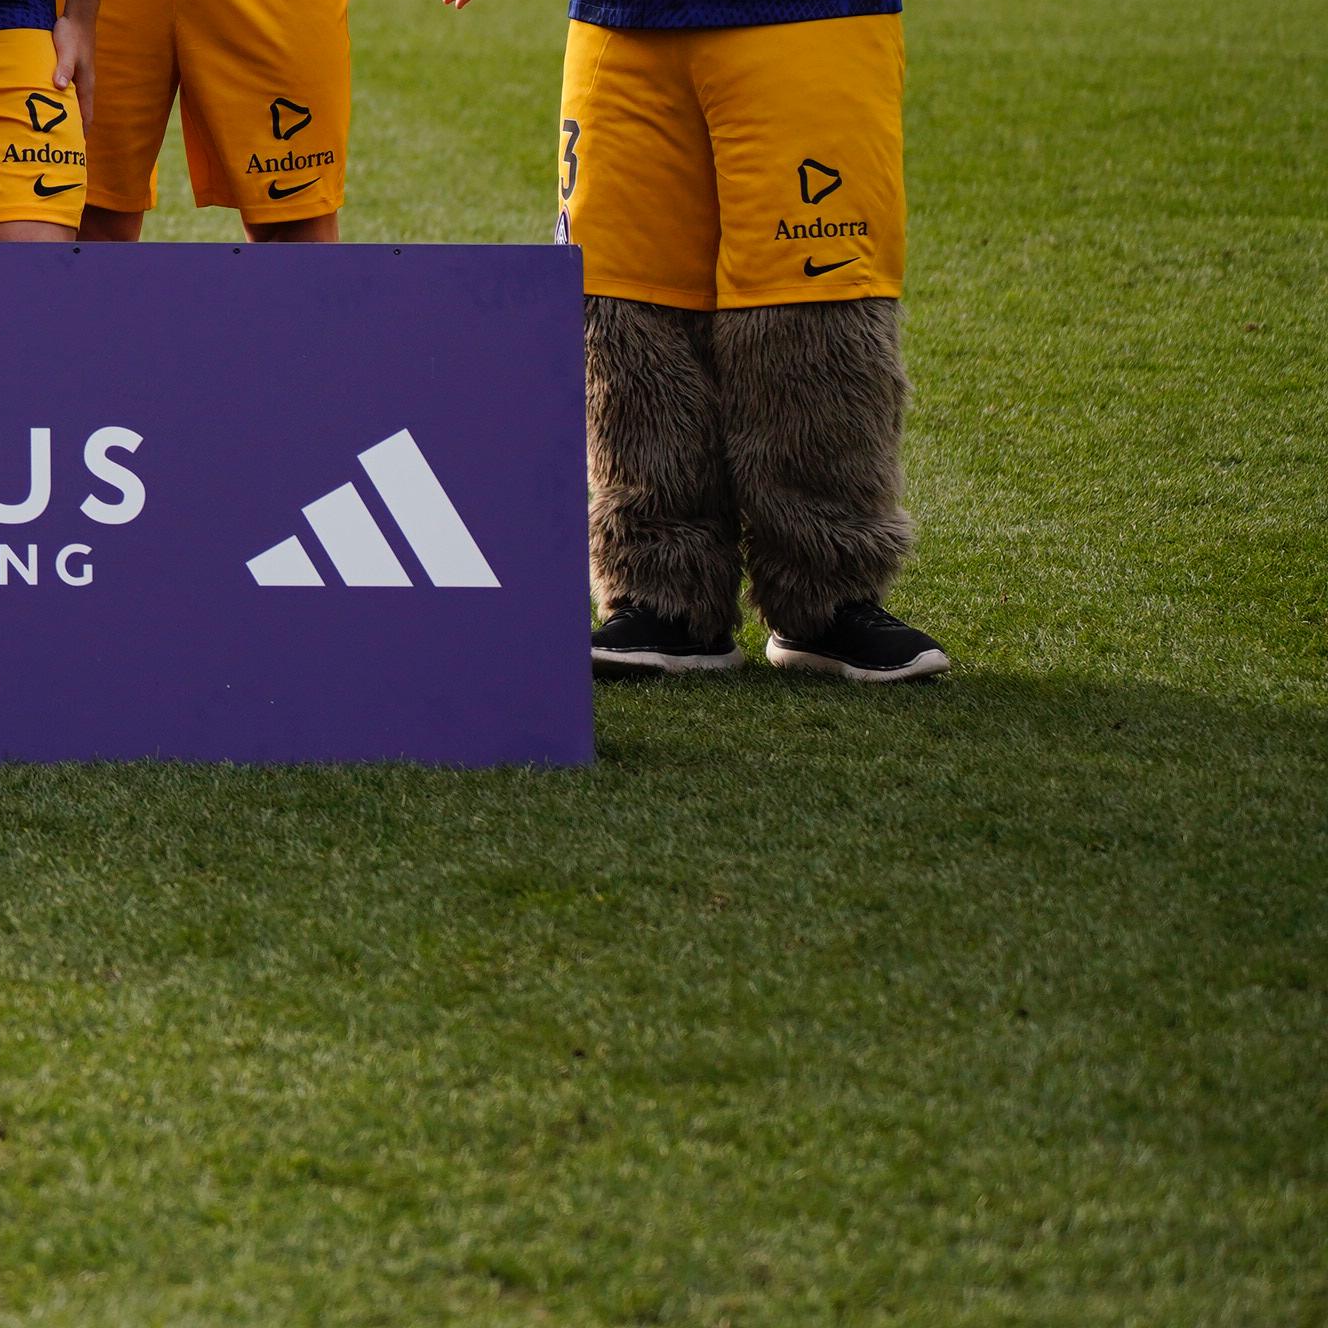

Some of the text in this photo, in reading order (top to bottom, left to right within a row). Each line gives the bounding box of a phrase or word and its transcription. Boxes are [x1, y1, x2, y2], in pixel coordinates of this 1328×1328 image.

[2, 143, 86, 167] Andorra
[246, 150, 336, 174] Andorra
[774, 217, 868, 241] Andorra
